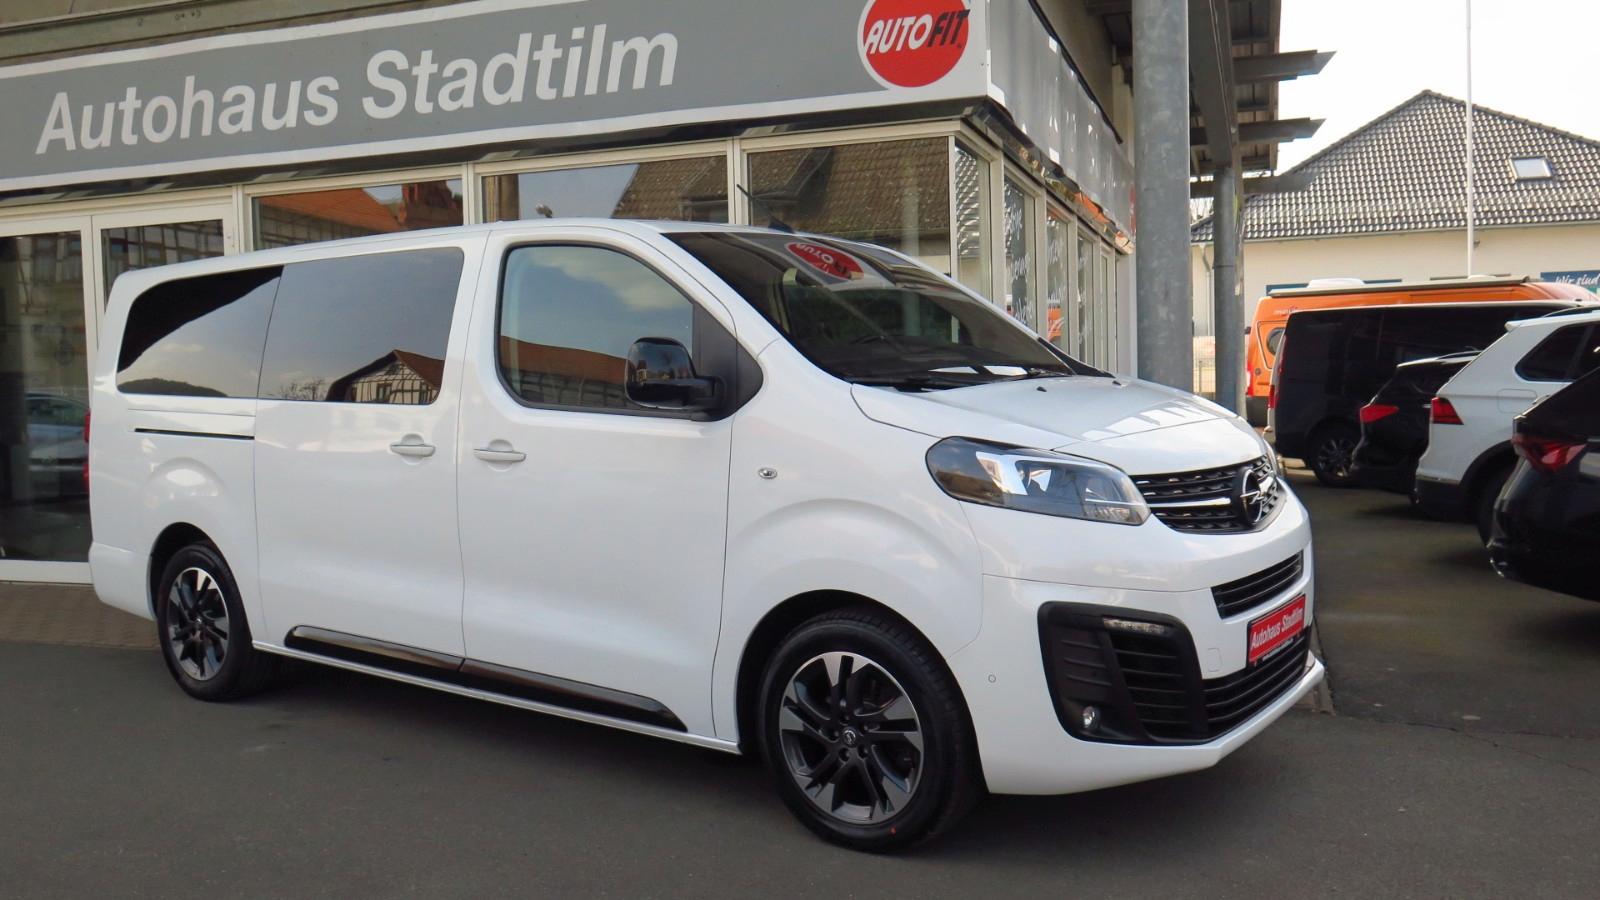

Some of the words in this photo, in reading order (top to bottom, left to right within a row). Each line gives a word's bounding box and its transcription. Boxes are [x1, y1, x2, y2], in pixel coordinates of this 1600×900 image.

[864, 9, 970, 54] AUTOFIT
[35, 75, 340, 155] Autohaus
[362, 23, 679, 119] Stadtilm
[1555, 274, 1575, 284] Wir
[1250, 622, 1280, 649] Autohaus
